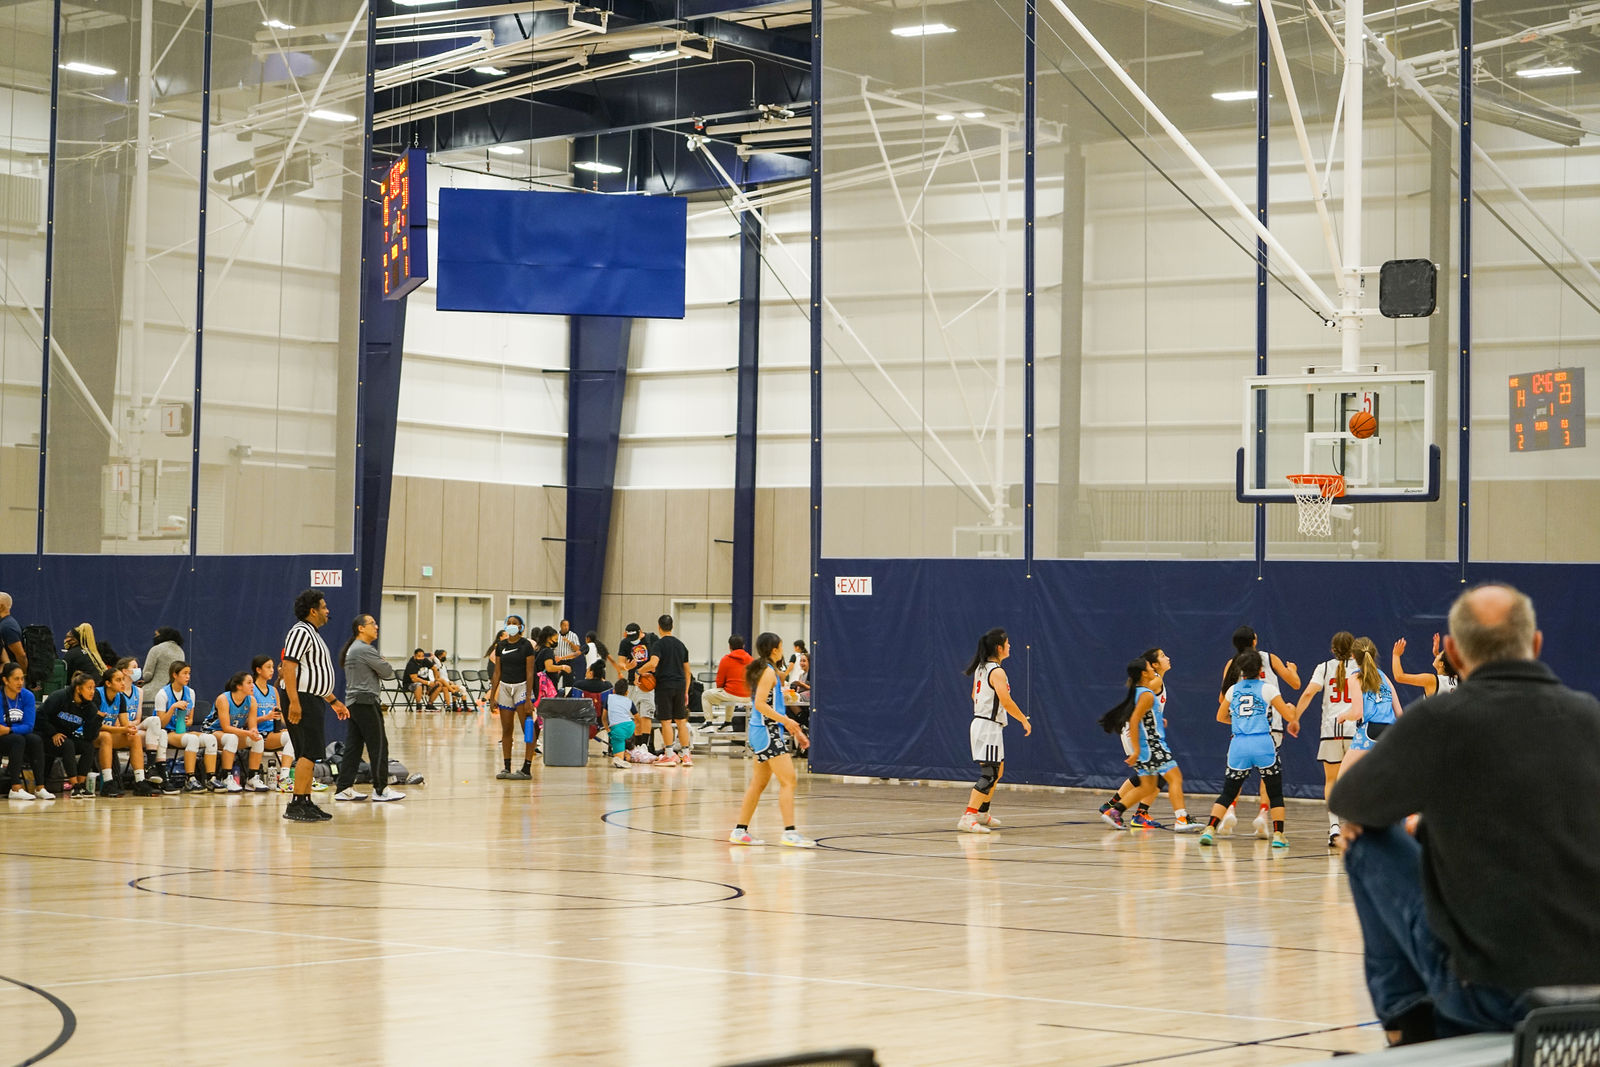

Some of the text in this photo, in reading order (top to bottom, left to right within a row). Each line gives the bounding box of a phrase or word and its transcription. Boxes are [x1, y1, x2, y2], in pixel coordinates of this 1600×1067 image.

[1559, 383, 1571, 404] 23
[1550, 402, 1554, 417] 1
[1518, 434, 1524, 450] 2
[1564, 430, 1570, 446] 3
[314, 571, 339, 585] EXIT
[840, 578, 868, 593] EXIT
[1239, 695, 1254, 717] 2
